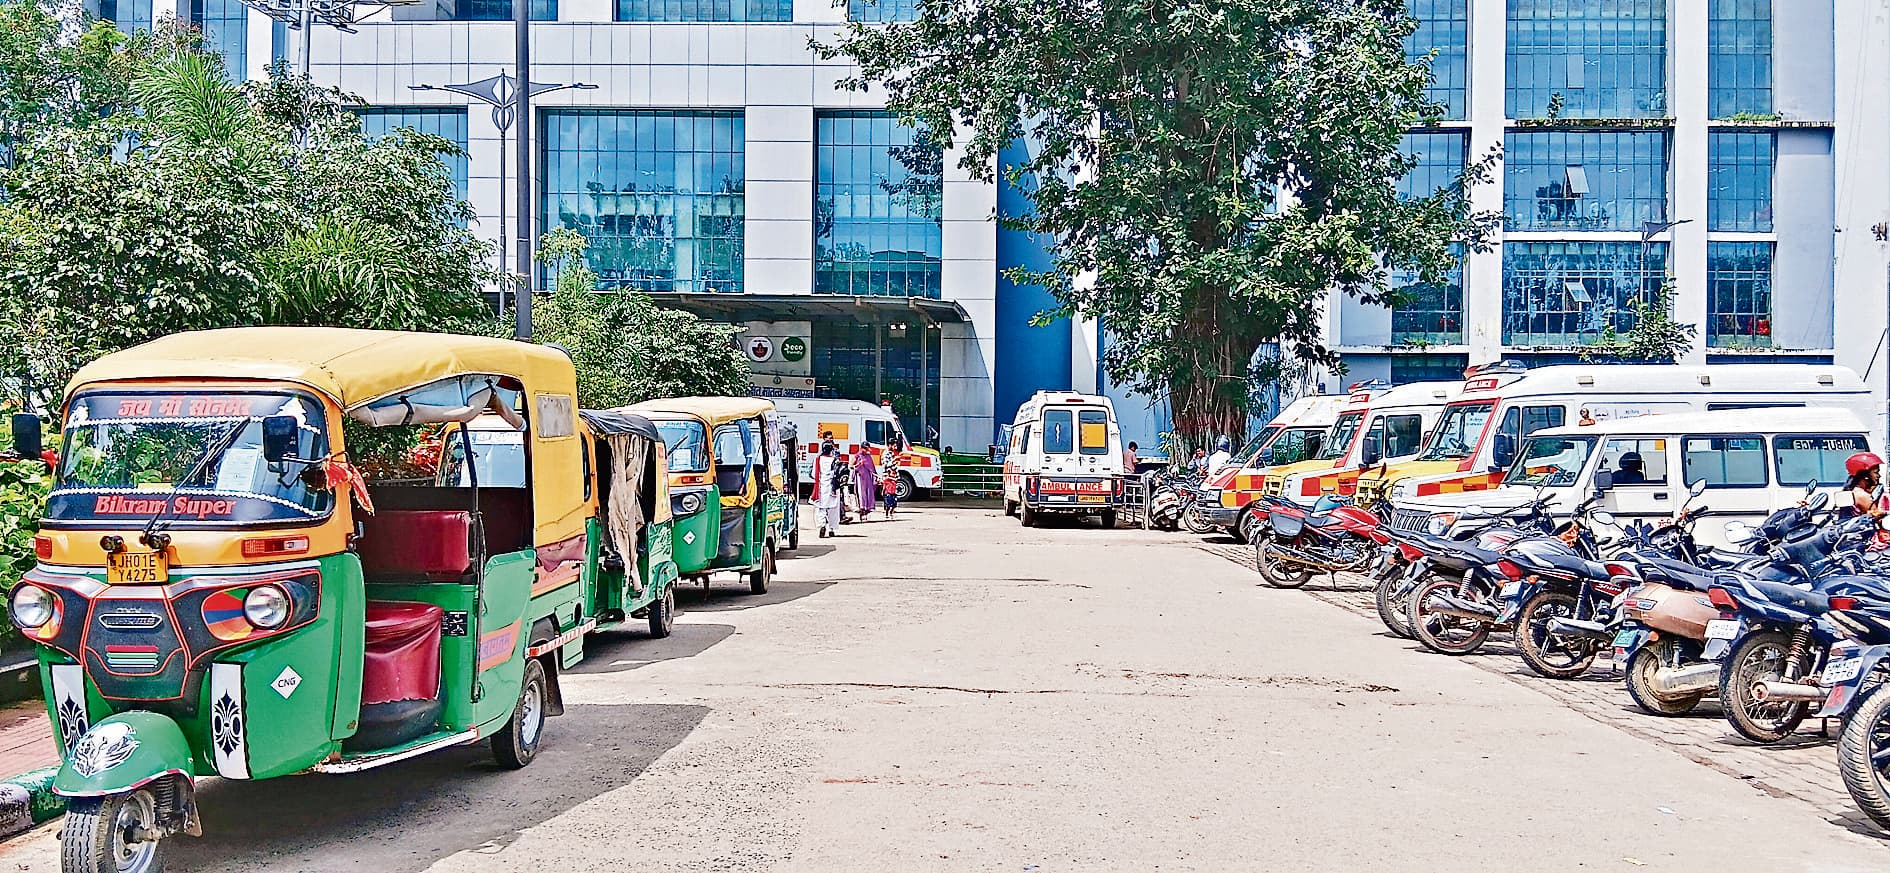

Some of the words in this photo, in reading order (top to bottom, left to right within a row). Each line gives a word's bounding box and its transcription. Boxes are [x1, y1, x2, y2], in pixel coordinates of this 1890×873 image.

[119, 399, 151, 416] जय
[94, 495, 168, 514] Bikram
[173, 496, 235, 519] Super
[118, 555, 156, 568] JH01E
[118, 568, 156, 581] Y4275
[278, 677, 296, 688] CNG
